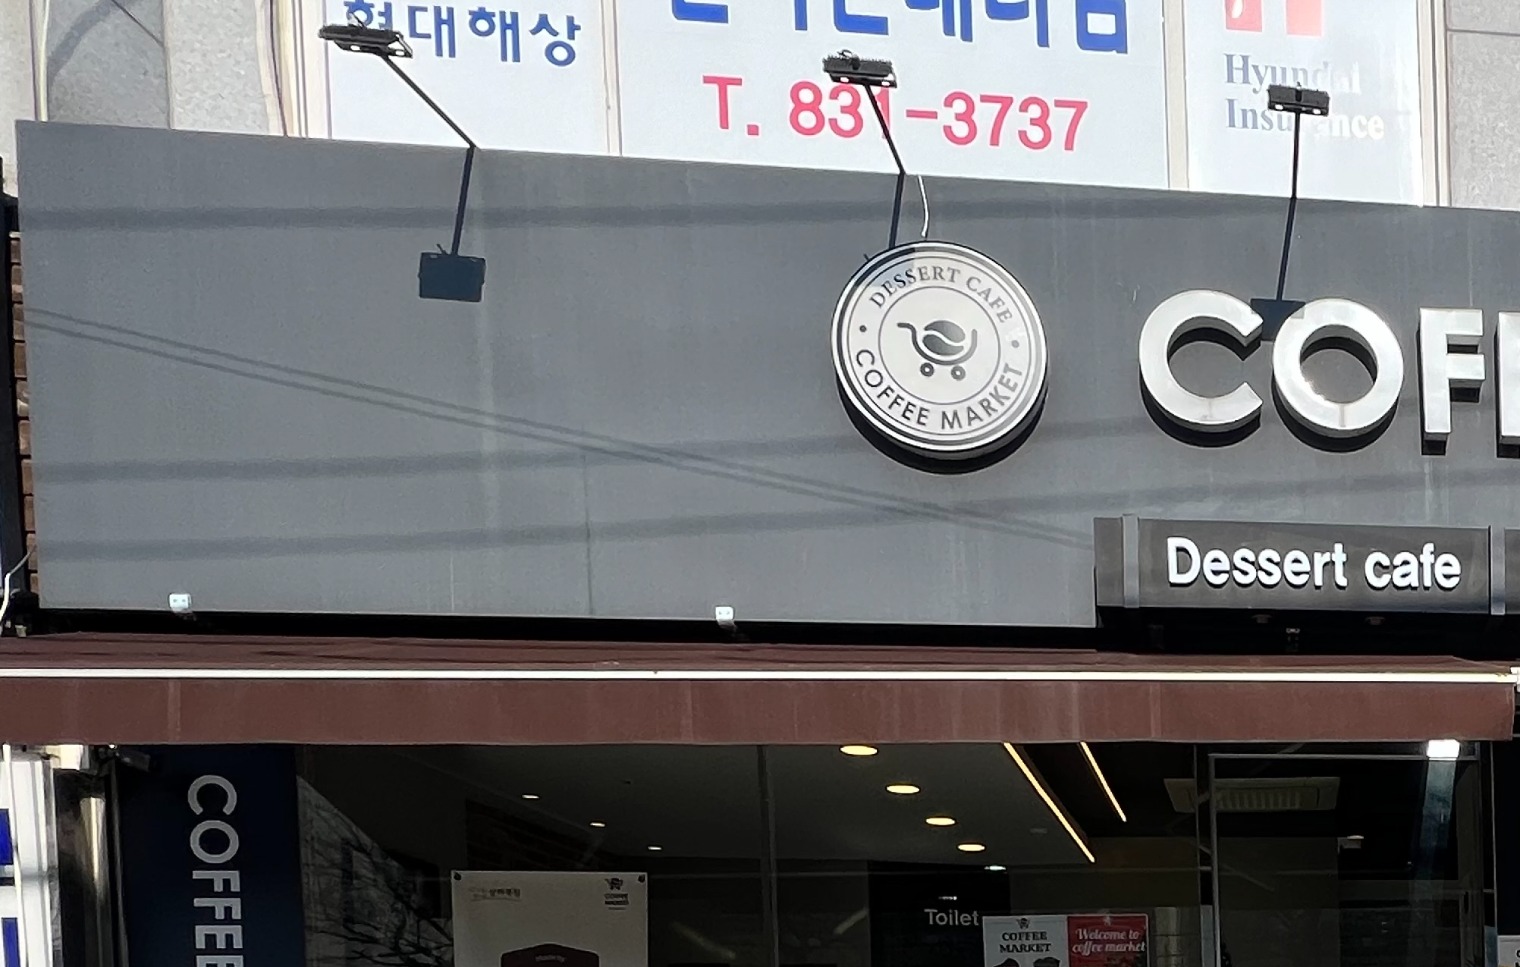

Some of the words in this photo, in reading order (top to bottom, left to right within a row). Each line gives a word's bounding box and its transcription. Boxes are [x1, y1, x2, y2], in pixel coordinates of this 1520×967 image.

[788, 81, 1089, 152] 831-3737
[869, 265, 961, 309] DESSERT
[966, 276, 1013, 324] CAFE
[856, 349, 931, 427] COFFEE
[941, 362, 1023, 430] MARKET
[1167, 536, 1348, 587] Dessert
[1364, 543, 1462, 589] cafe
[924, 909, 979, 926] Toilet
[1002, 931, 1048, 941] COFFEE
[1076, 928, 1126, 940] Welcome
[1129, 929, 1139, 940] to
[1000, 943, 1051, 953] MARKET
[1072, 942, 1103, 956] coffee
[1105, 941, 1146, 952] market
